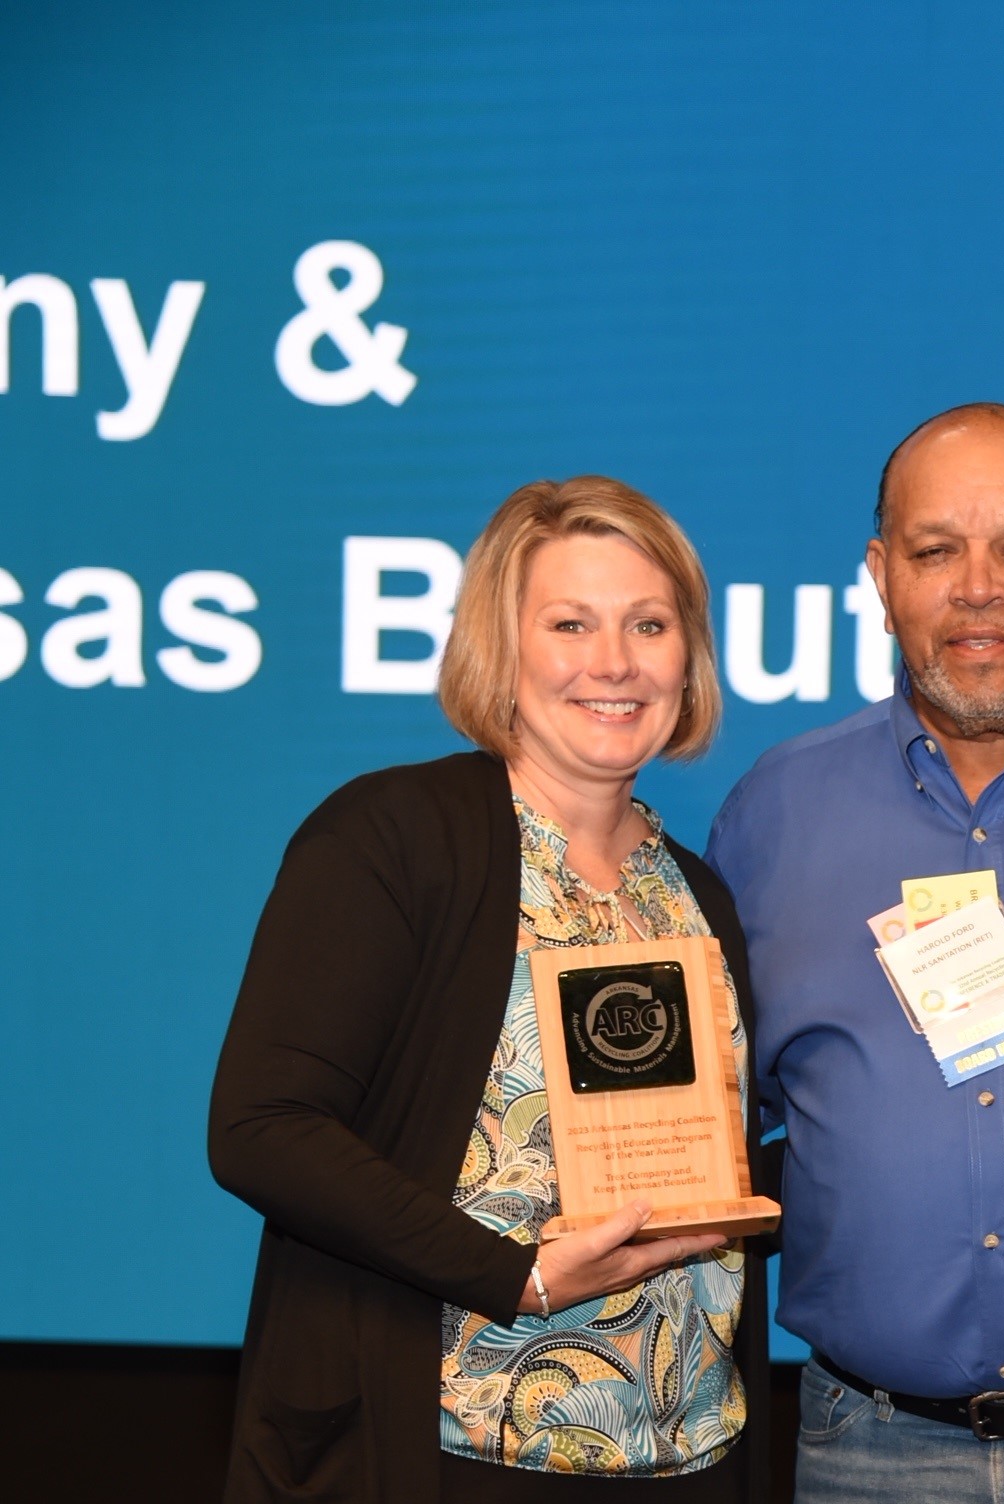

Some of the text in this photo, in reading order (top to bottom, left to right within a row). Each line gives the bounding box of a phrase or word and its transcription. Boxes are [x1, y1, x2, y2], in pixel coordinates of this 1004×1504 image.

[0, 239, 418, 442] ny &
[0, 565, 263, 692] as
[917, 924, 975, 955] HAROLD FORD
[928, 941, 972, 967] SANITATION
[605, 985, 639, 995] ARKANSAS
[591, 1003, 664, 1036] ARC
[572, 1003, 681, 1073] Advancing Sustainable Materials Management
[598, 1036, 660, 1058] RECYCLING COALITION
[568, 1115, 716, 1136] 2023 Arkansas Recycling Coalition
[576, 1133, 712, 1152] Recycling Education Program
[617, 1151, 632, 1159] the
[636, 1149, 653, 1157] Year
[657, 1146, 686, 1155] Award
[620, 1182, 661, 1192] Arkansas
[664, 1176, 706, 1187] Beautiful
[628, 1168, 671, 1180] Company
[674, 1166, 691, 1175] and
